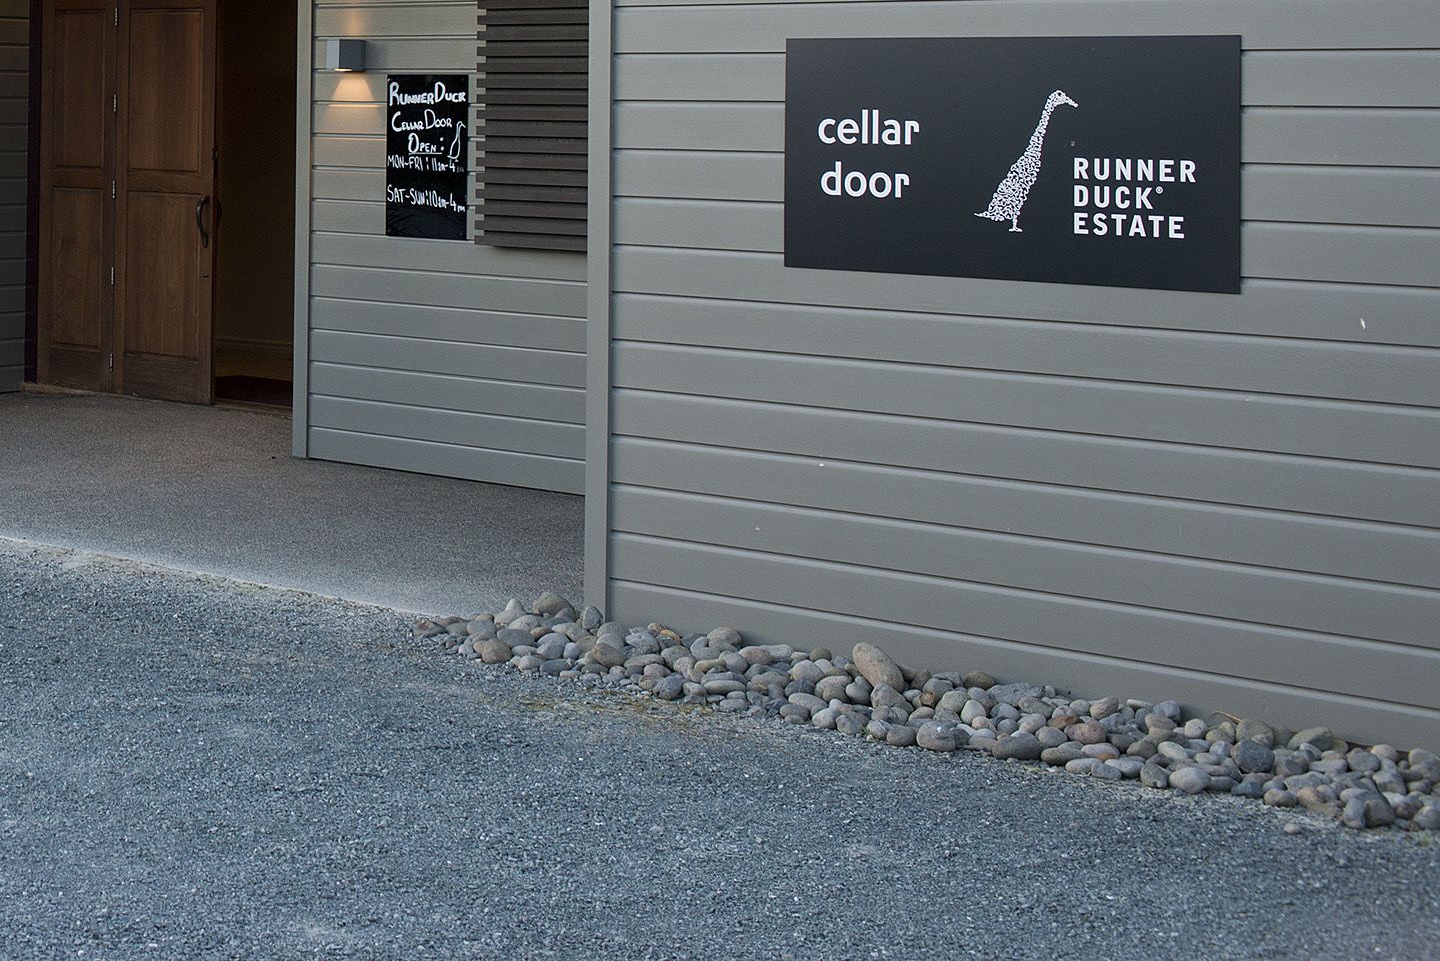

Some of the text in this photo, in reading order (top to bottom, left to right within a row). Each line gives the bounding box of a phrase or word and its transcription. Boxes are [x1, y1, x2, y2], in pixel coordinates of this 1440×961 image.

[424, 109, 453, 129] DOOR
[817, 109, 920, 146] cellar
[820, 160, 911, 199] door
[1073, 156, 1197, 183] RUNNER
[1073, 212, 1185, 239] ESTATE
